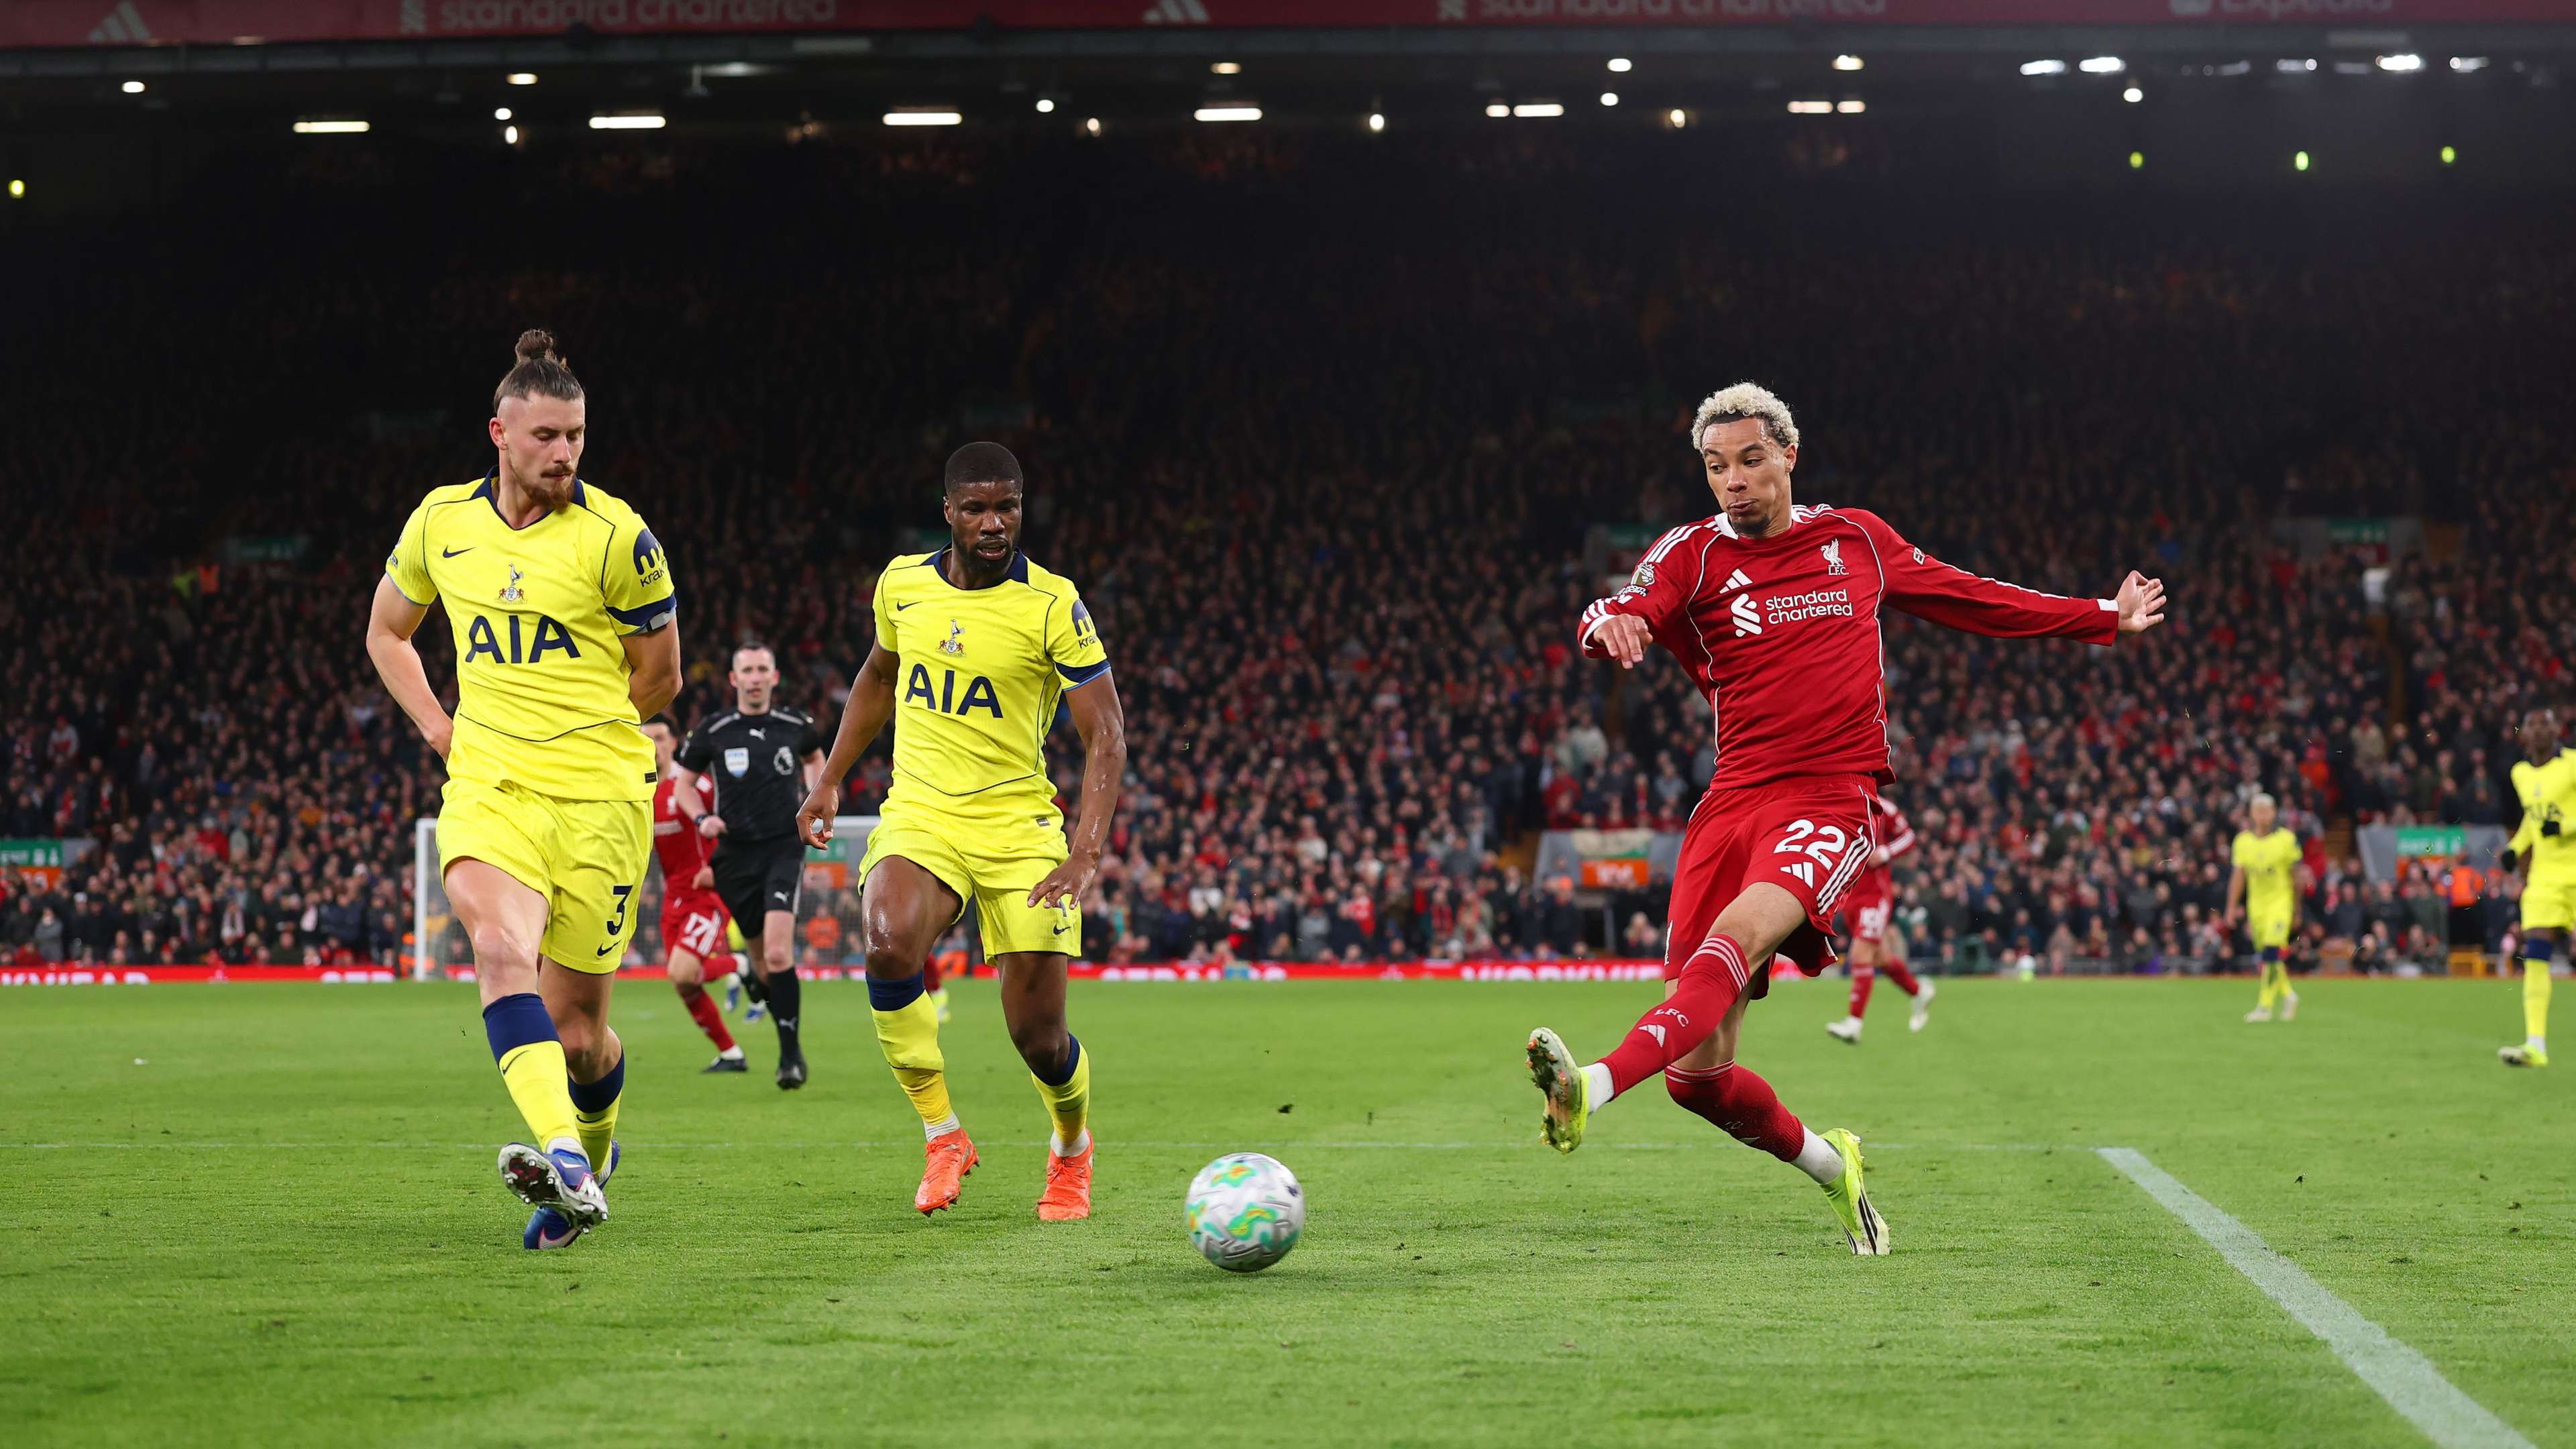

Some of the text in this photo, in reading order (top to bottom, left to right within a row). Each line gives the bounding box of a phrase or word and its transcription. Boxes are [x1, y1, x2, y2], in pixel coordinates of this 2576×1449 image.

[1765, 588, 1848, 611] standard
[1768, 602, 1854, 625] chartered
[466, 615, 582, 664] AIA
[904, 663, 1004, 718] AIA
[1773, 818, 1846, 871] 22
[606, 885, 633, 936] 3
